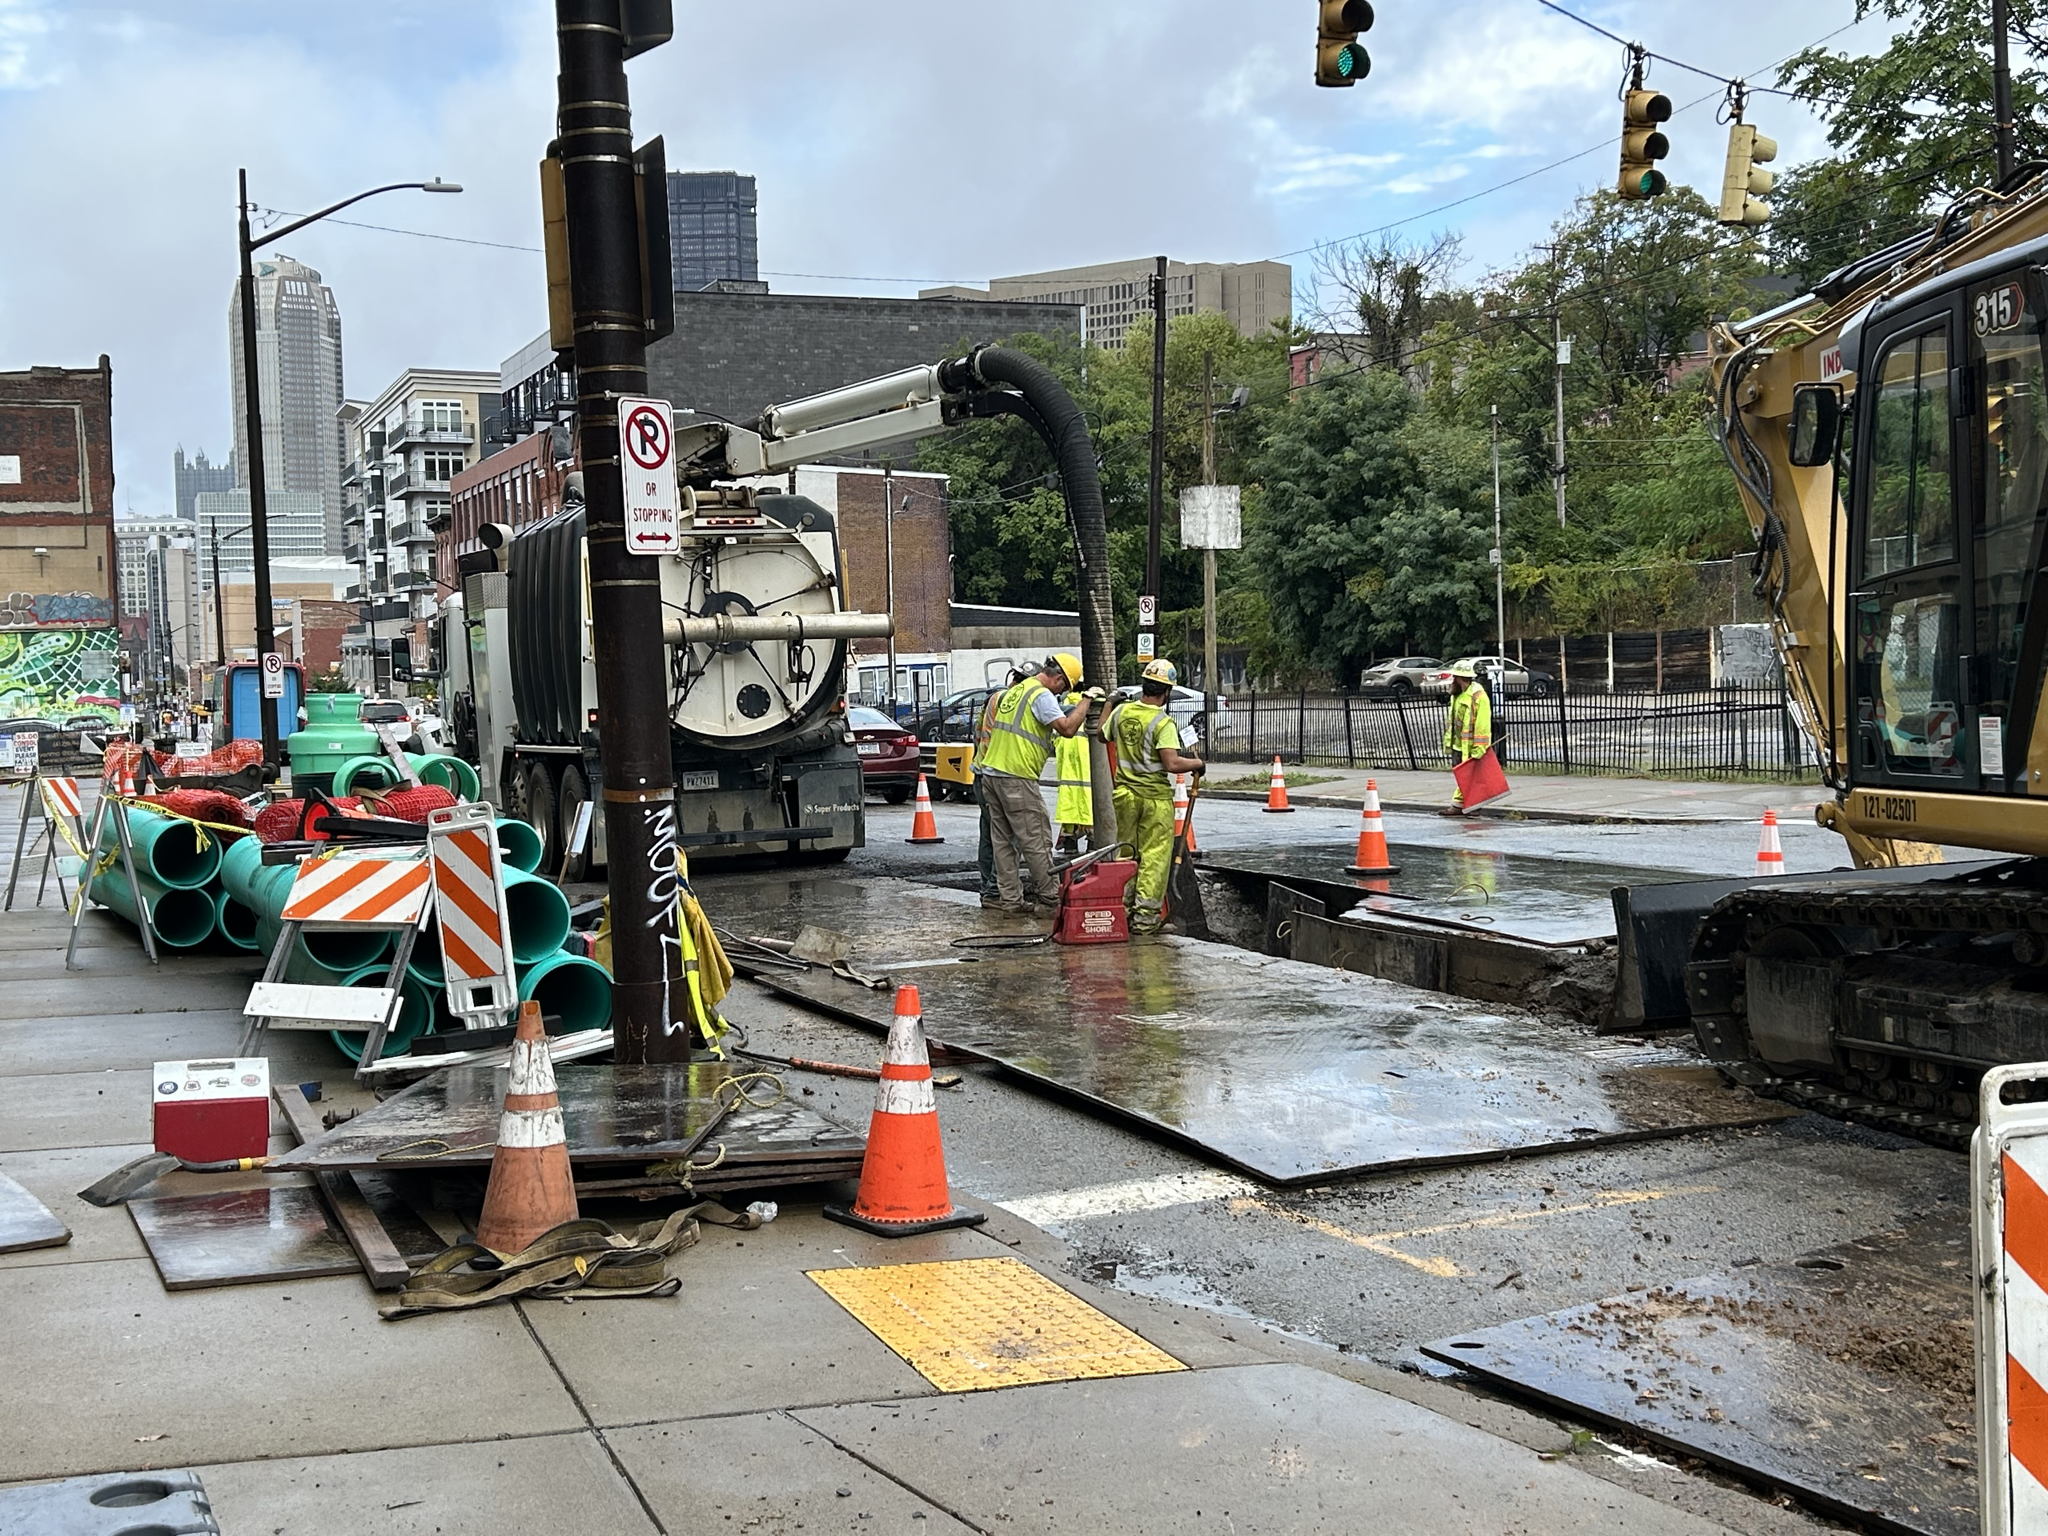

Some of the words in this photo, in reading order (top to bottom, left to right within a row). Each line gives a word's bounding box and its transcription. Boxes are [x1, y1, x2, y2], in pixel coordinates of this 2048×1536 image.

[1976, 287, 2011, 332] 315
[645, 482, 657, 496] OR
[633, 507, 673, 523] STOPPING
[1862, 795, 1917, 822] 121-02501
[1084, 910, 1112, 918] SPEED
